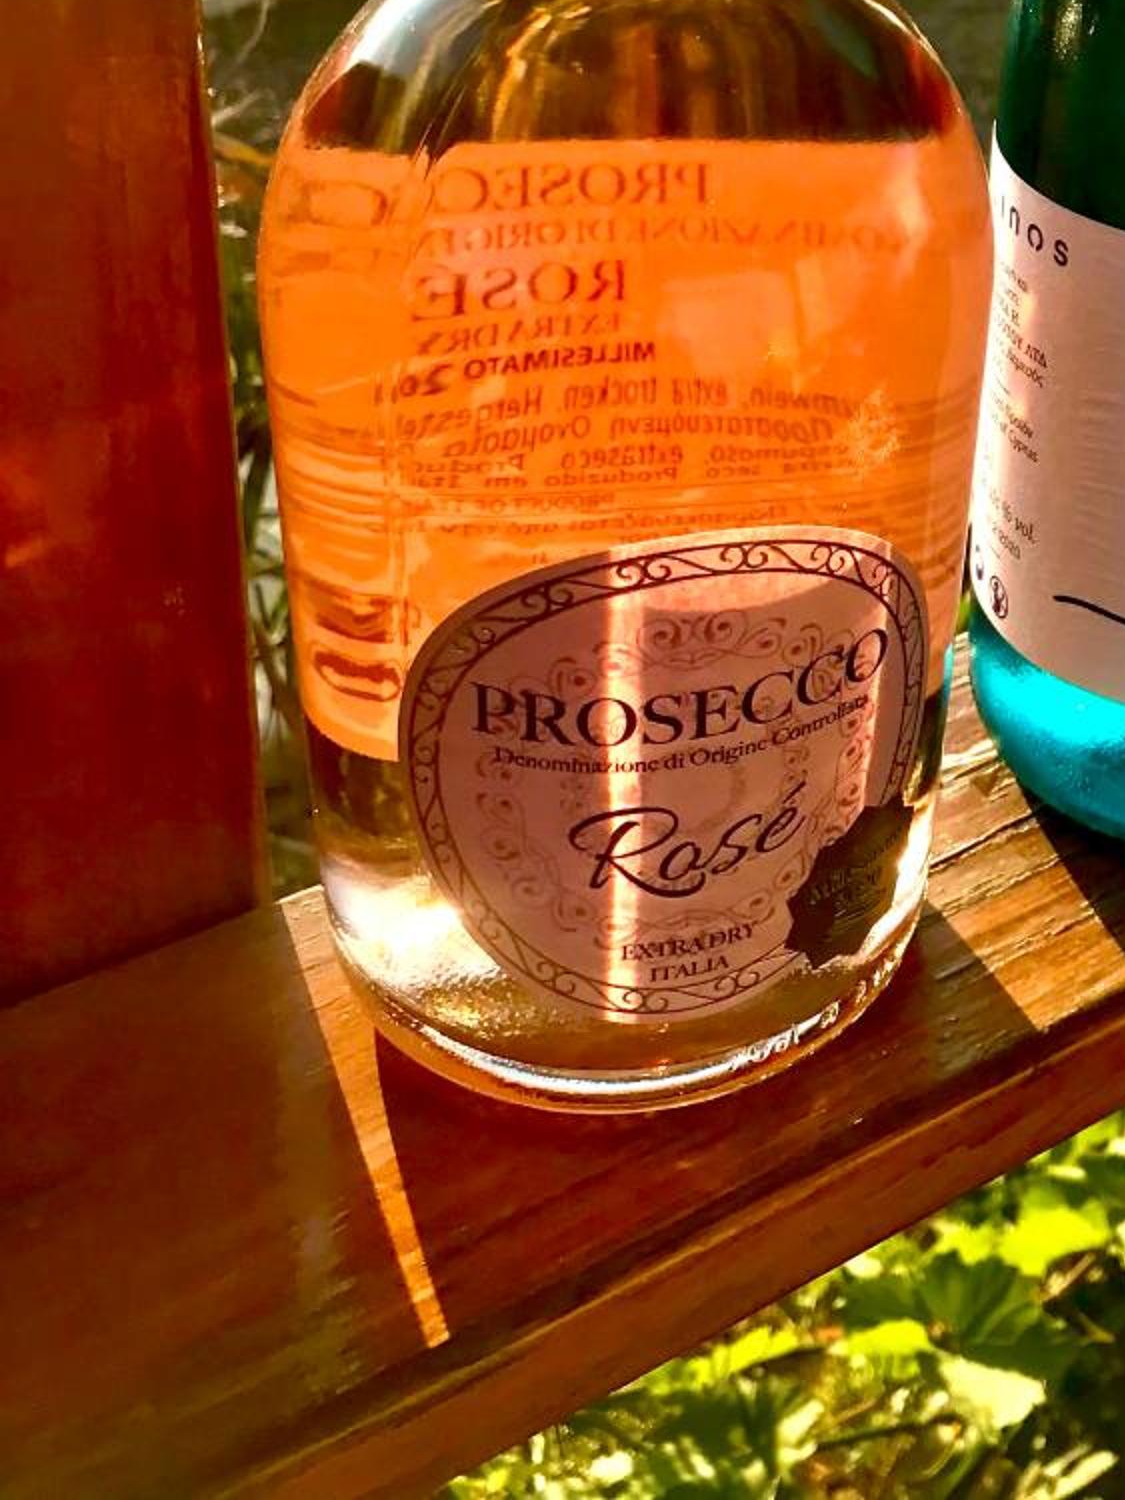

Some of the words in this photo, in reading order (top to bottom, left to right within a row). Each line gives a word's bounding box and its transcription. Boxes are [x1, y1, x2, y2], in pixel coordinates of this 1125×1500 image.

[470, 627, 890, 749] PROSECCO
[493, 745, 662, 774] Denominazione
[665, 751, 686, 771] di
[689, 738, 768, 766] Origine
[568, 781, 807, 899] Rosé
[621, 935, 704, 962] EXTRA
[650, 955, 730, 983] ITALIA
